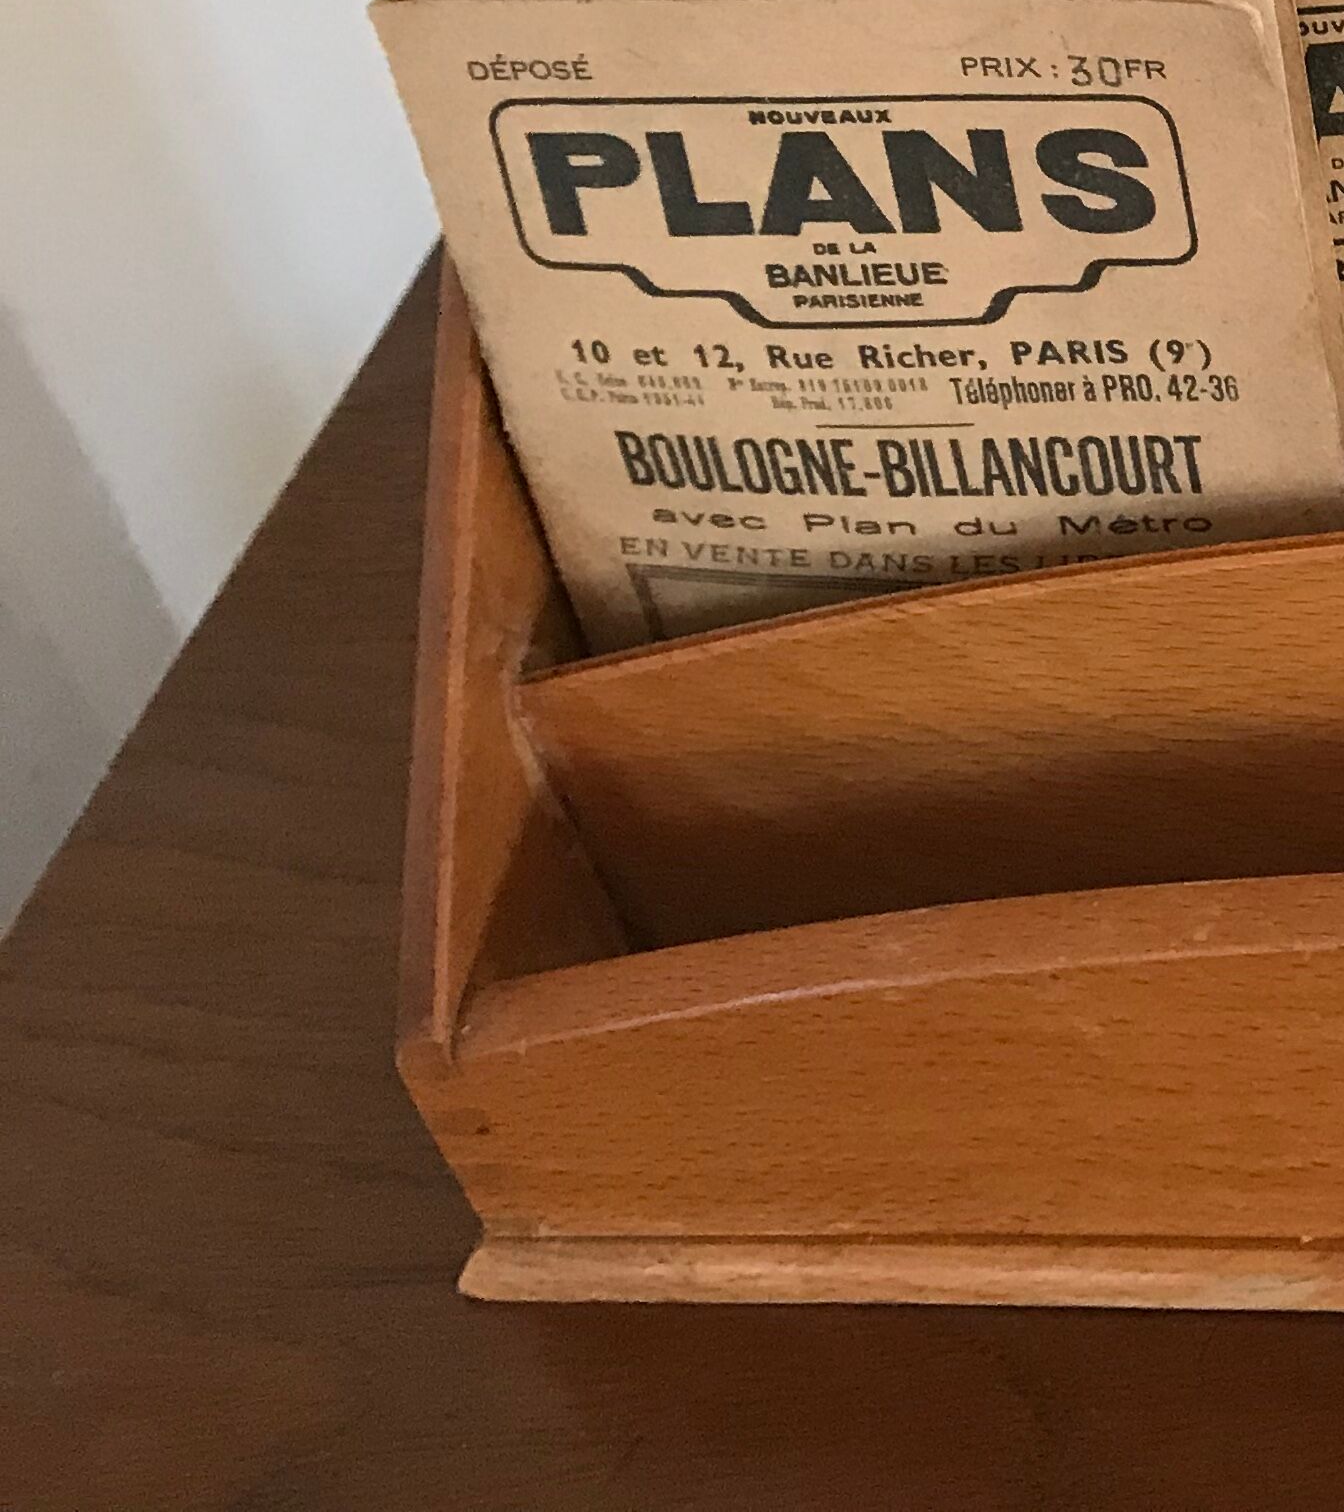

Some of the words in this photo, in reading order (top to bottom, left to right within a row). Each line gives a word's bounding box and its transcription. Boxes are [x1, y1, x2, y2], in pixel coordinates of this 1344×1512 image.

[466, 53, 593, 81] DÉPOSÉ
[747, 109, 892, 126] NOUVEAUX
[524, 128, 1157, 237] PLANS
[812, 242, 841, 256] DE
[849, 241, 877, 255] LA
[765, 262, 949, 289] BANLIEUE
[792, 293, 924, 309] PARISIENNE
[571, 338, 612, 365] 10
[632, 345, 669, 368] et
[692, 343, 745, 372] 12,
[766, 344, 834, 370] Rue
[857, 342, 988, 371] Richer,
[1010, 339, 1129, 366] PARIS
[948, 374, 1076, 410] Téléphoner
[1082, 374, 1098, 402] à
[1101, 373, 1162, 403] PRO.
[1166, 373, 1241, 403] 42-36
[614, 430, 1203, 498] BOULOGNE-BILLANCOURT
[652, 507, 768, 531] avec
[803, 511, 917, 535] Plan
[954, 517, 1019, 537] du
[1059, 513, 1213, 537] Métro
[619, 536, 669, 558] EN
[683, 540, 813, 569] VENTE
[828, 549, 947, 575] DANS
[951, 553, 1020, 575] LES
